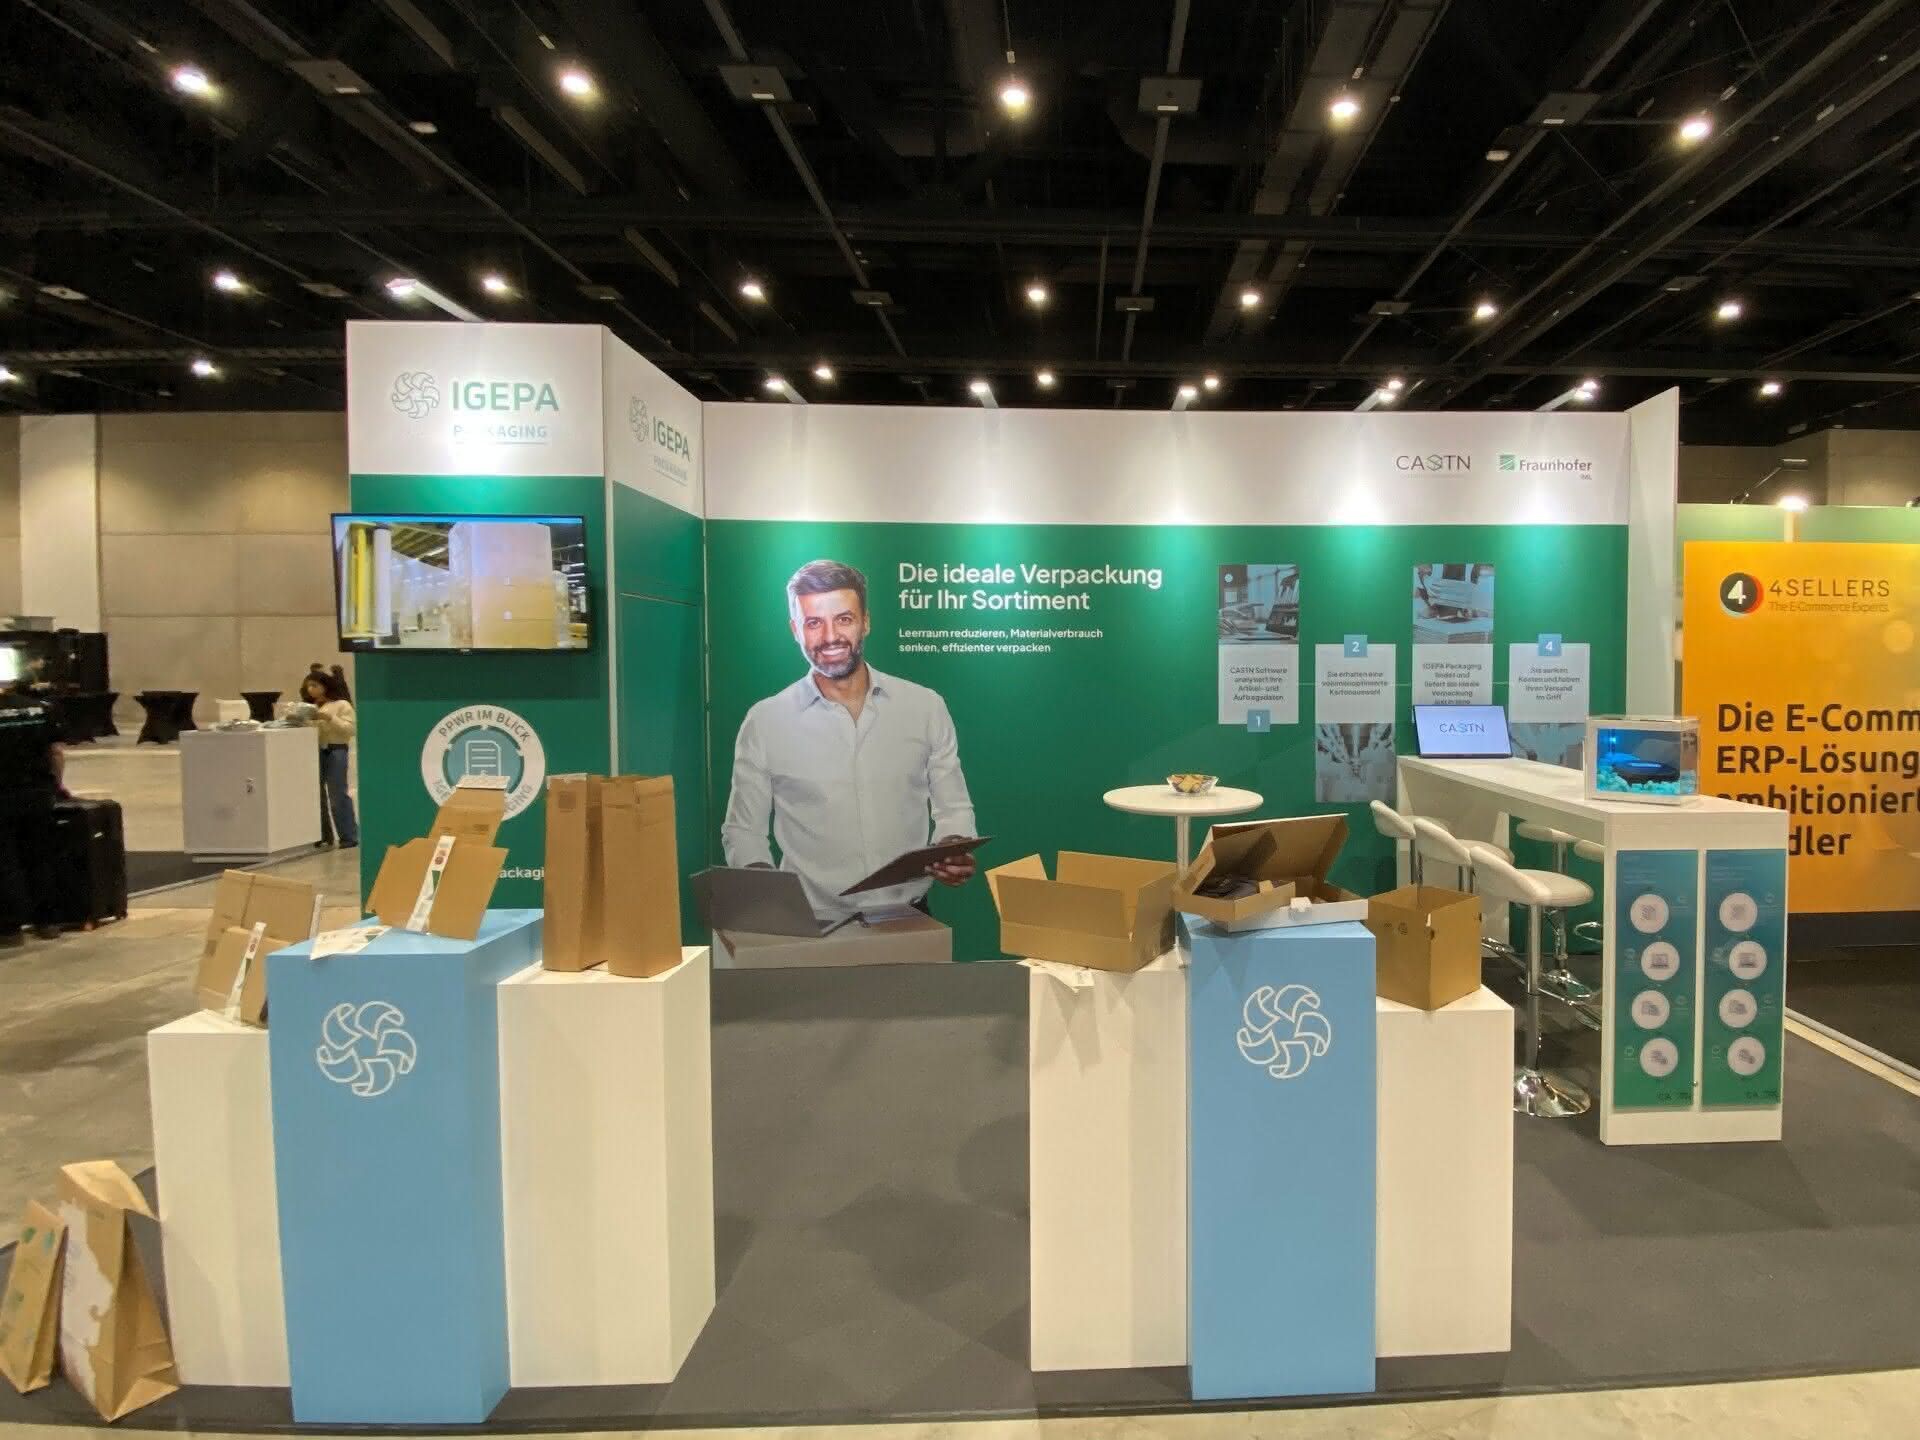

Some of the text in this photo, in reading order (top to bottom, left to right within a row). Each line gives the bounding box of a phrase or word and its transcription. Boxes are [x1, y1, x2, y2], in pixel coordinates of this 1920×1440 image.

[452, 382, 559, 411] IGEPA
[652, 416, 691, 462] IGEPA
[1396, 454, 1471, 471] CASTN
[1519, 459, 1592, 471] Fraunhofer
[899, 563, 1162, 589] Die ideale Verpackung
[1769, 579, 1889, 597] 4SELLERS
[899, 589, 1090, 610] für Ihr Sortiment
[1768, 601, 1789, 612] The
[1789, 601, 1851, 612] E-Commerce
[899, 628, 1103, 640] Leerraum reduzieren, Materialverbrauch
[899, 643, 1051, 654] senken, effizienter verpacken
[1352, 641, 1360, 652] 2
[1545, 641, 1553, 652] 4
[1255, 715, 1261, 727] 1
[1718, 701, 1920, 732] Die E-Comm
[439, 710, 531, 742] PPWR IM BLICK
[1439, 723, 1486, 733] CASTN
[1717, 743, 1919, 779] ERP-Lösung
[1789, 825, 1852, 856] dler
[500, 866, 544, 880] ackagi
